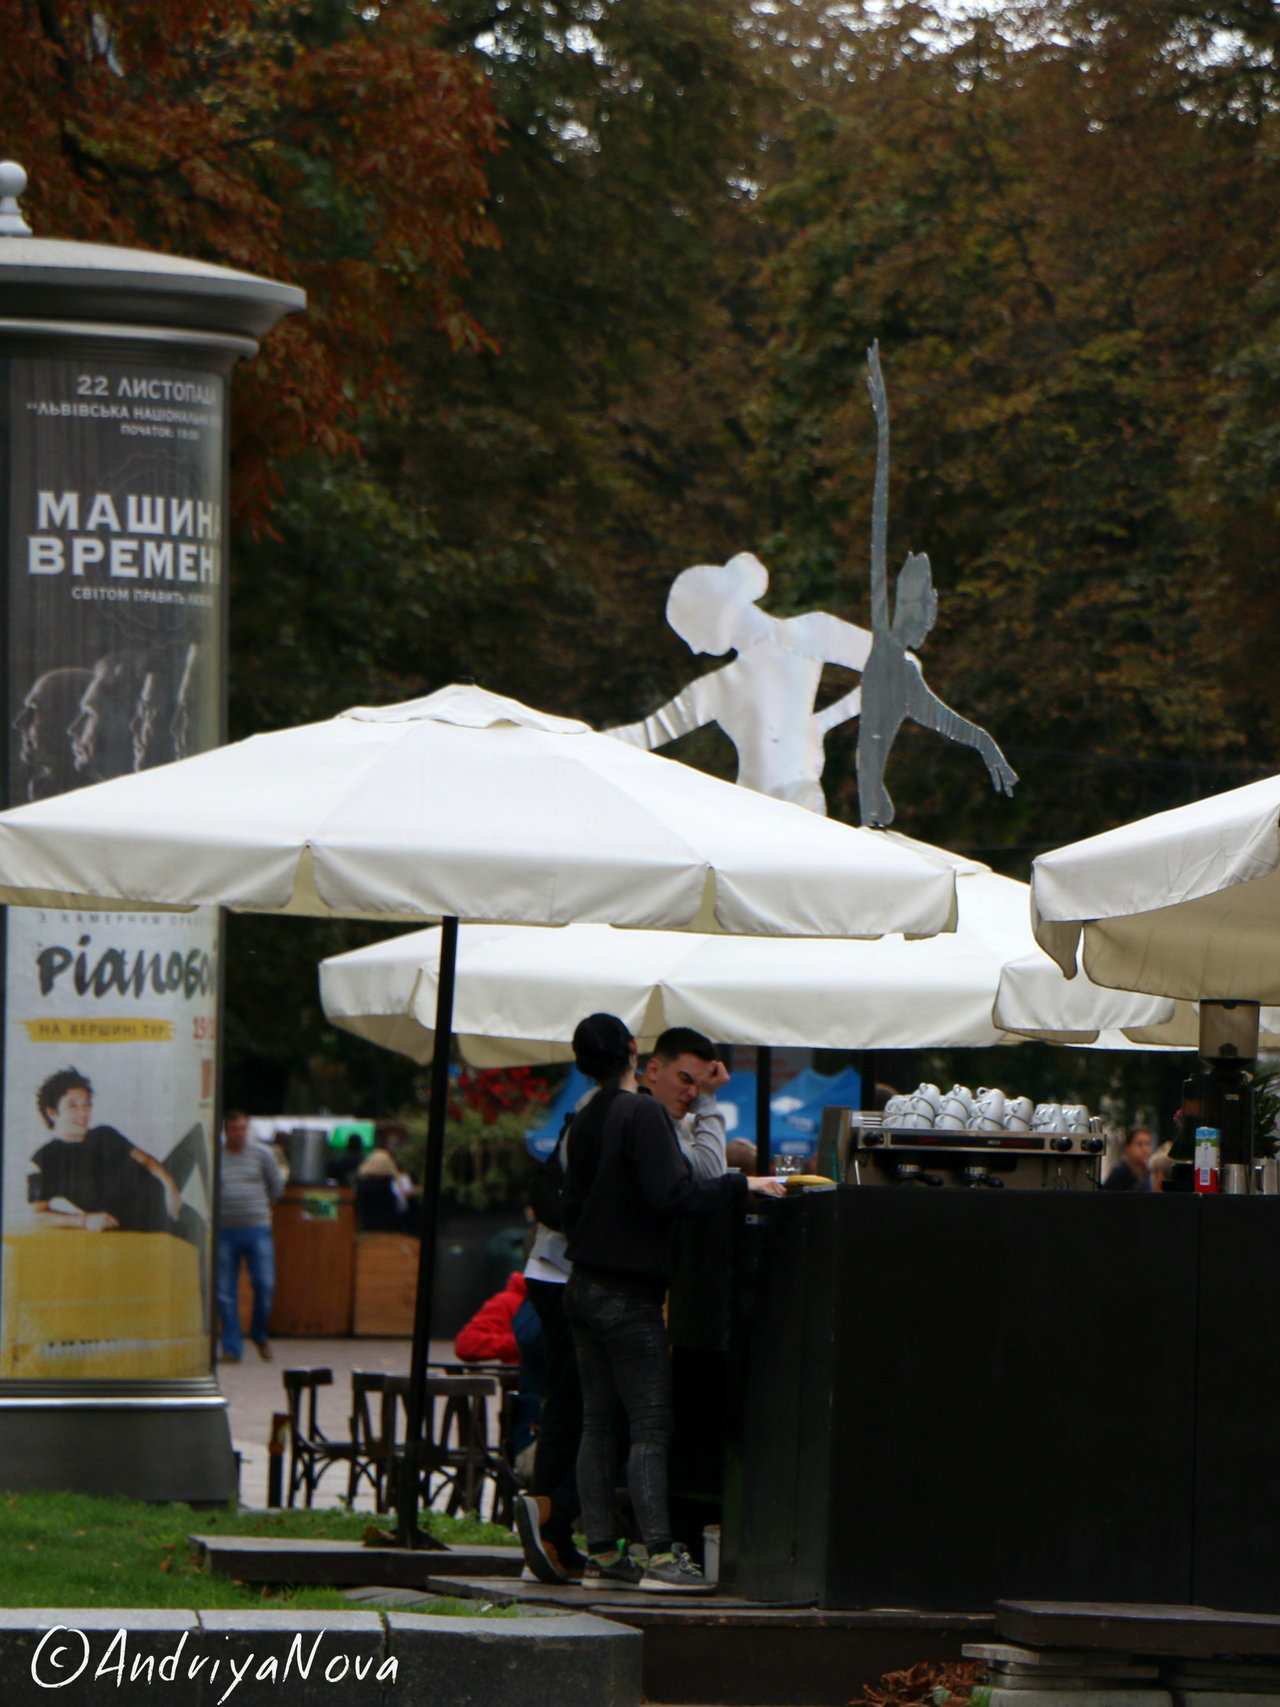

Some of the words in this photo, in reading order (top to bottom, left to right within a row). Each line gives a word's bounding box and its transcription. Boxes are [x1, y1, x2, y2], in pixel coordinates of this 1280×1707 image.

[77, 375, 109, 396] 22
[28, 537, 220, 584] ВРЕМЕН
[71, 587, 129, 601] СВІТОМ
[39, 1024, 61, 1036] НА
